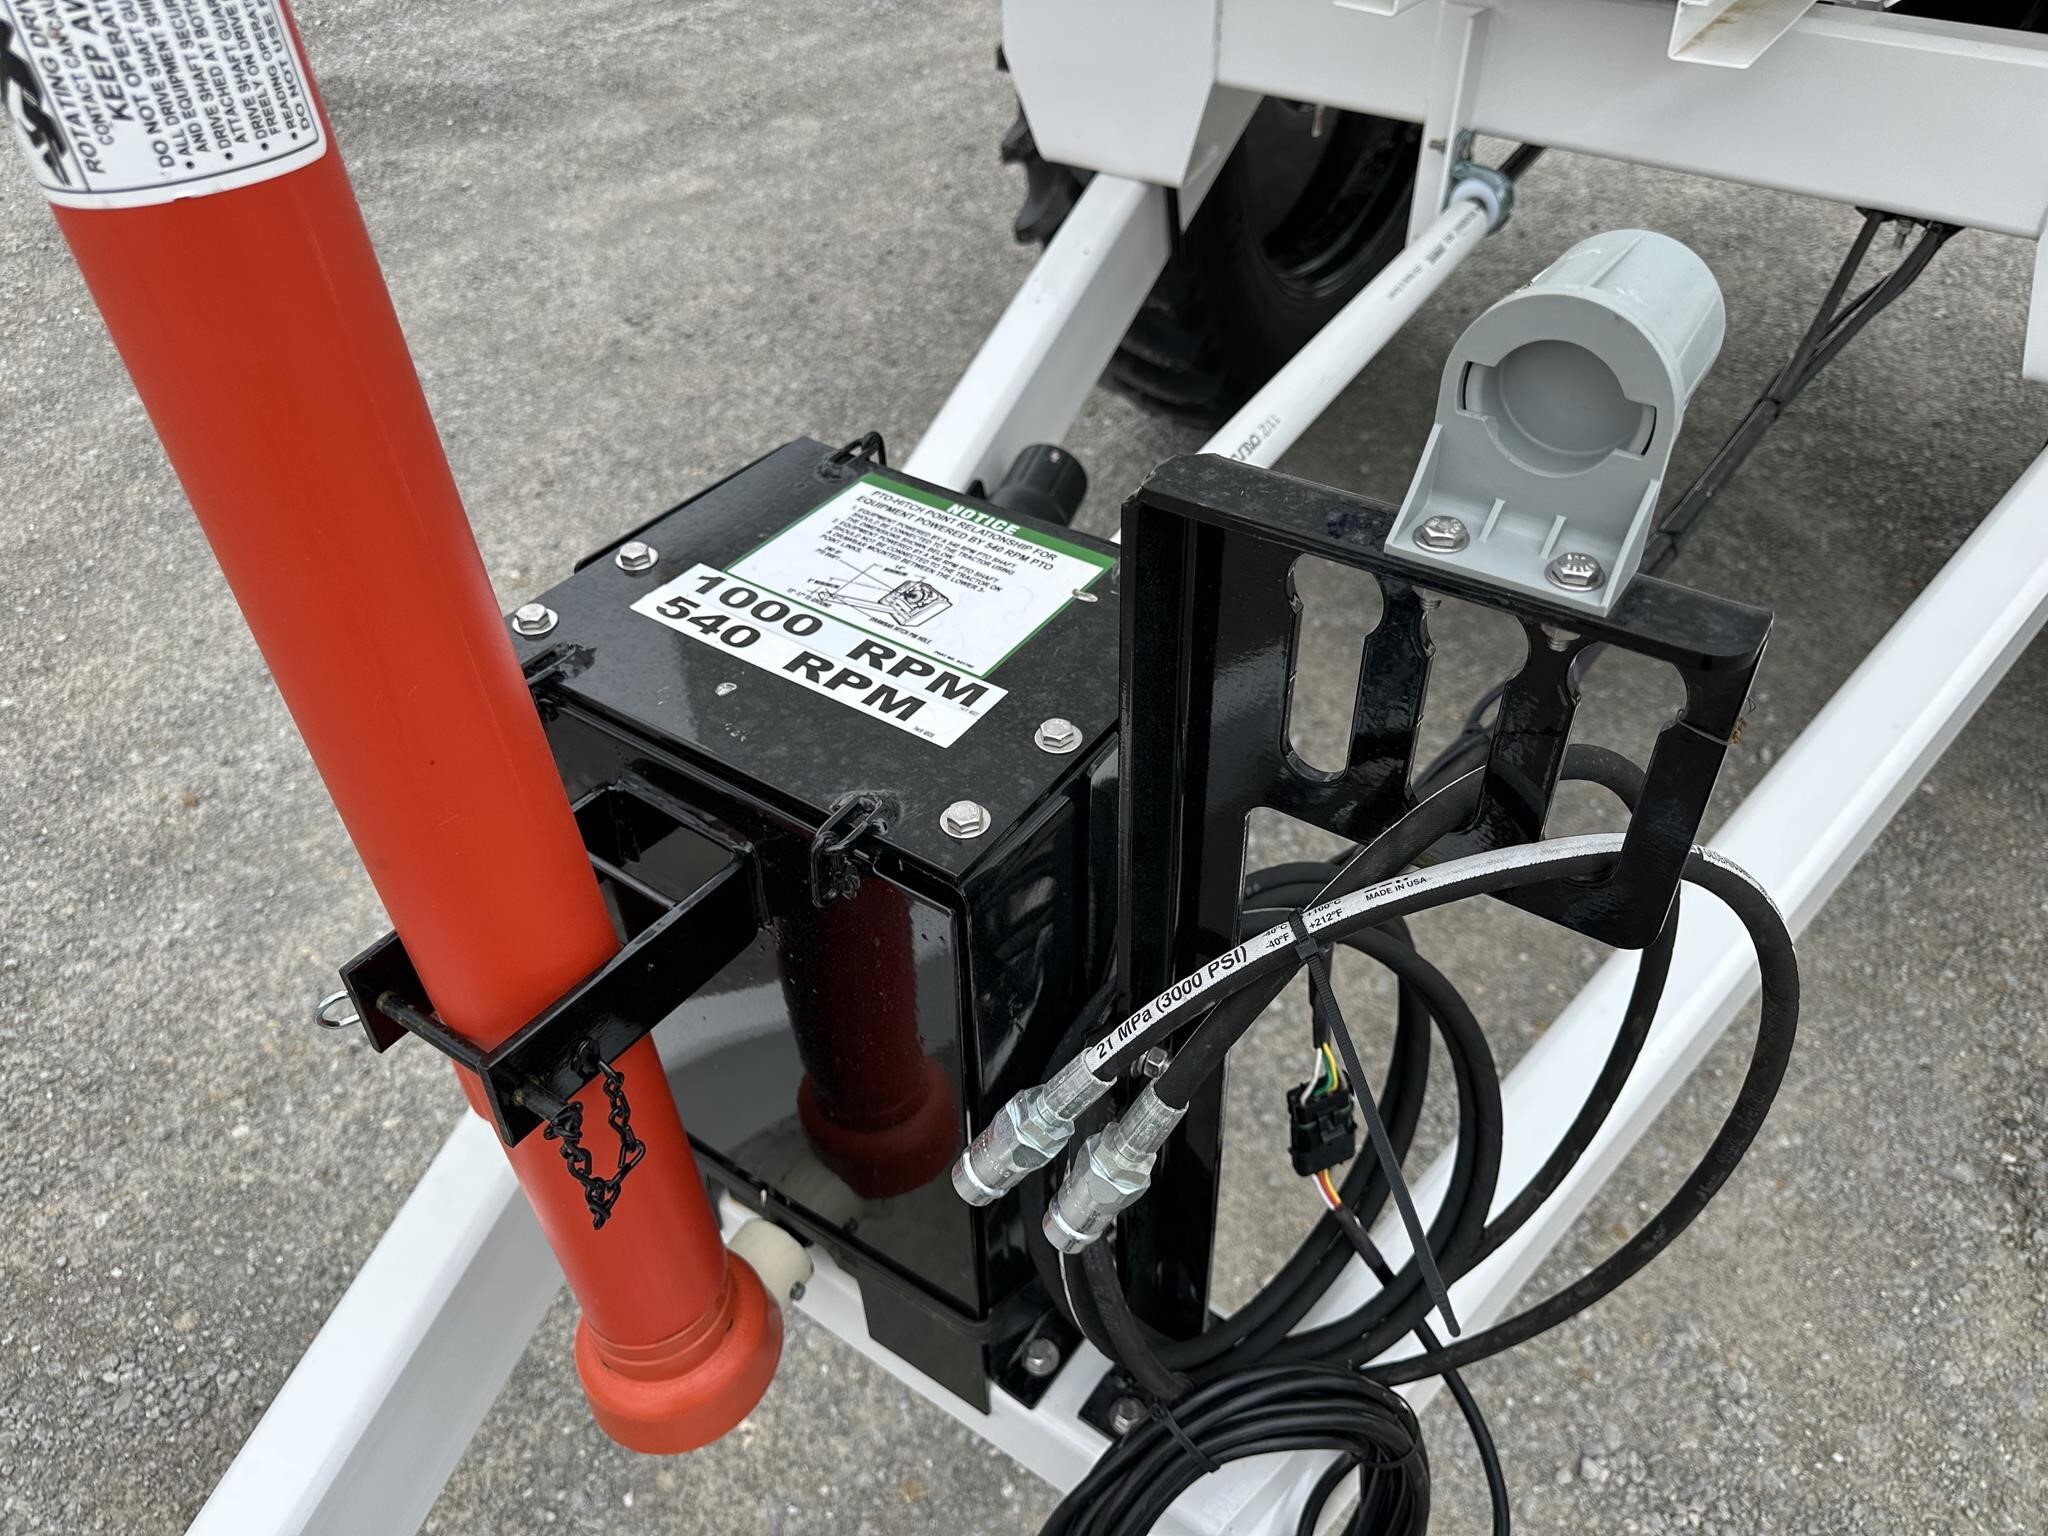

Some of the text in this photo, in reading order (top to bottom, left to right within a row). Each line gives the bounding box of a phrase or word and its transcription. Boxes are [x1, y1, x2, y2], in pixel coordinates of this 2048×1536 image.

[54, 35, 81, 68] CAN
[82, 44, 134, 121] KEEP
[92, 0, 175, 168] DO NOT OPERAT
[128, 28, 161, 77] SHAFT
[150, 33, 196, 119] EQUIPMENT
[184, 54, 214, 102] SHAFT
[199, 44, 218, 61] AT
[223, 46, 251, 93] SHAFT
[225, 6, 281, 136] FREELY ON DRIVE
[242, 0, 297, 130] READING OPERAT
[263, 13, 310, 131] DO NOT USE
[14, 0, 105, 174] ROTATING DRI
[71, 74, 114, 145] CONTACT
[151, 81, 180, 126] DRIVE
[209, 66, 248, 143] ATTACHED
[242, 96, 268, 140] DRIVE
[172, 129, 193, 156] ALL
[188, 123, 210, 152] AND
[204, 106, 232, 149] DRIVE
[856, 496, 1054, 570] EQUIPMENT POWERED BY 540 RPM PTO
[871, 491, 1057, 561] PTO-HITCH POINT RELATIONSHIP FOR
[946, 503, 1020, 536] NOTICE
[656, 596, 927, 722] 540 RPM
[695, 575, 989, 708] 1000 RPM
[1365, 886, 1392, 902] MADE
[1394, 882, 1405, 895] IN
[1406, 876, 1427, 889] USA
[1096, 946, 1248, 1059] 21 MPa (3000 PSI)
